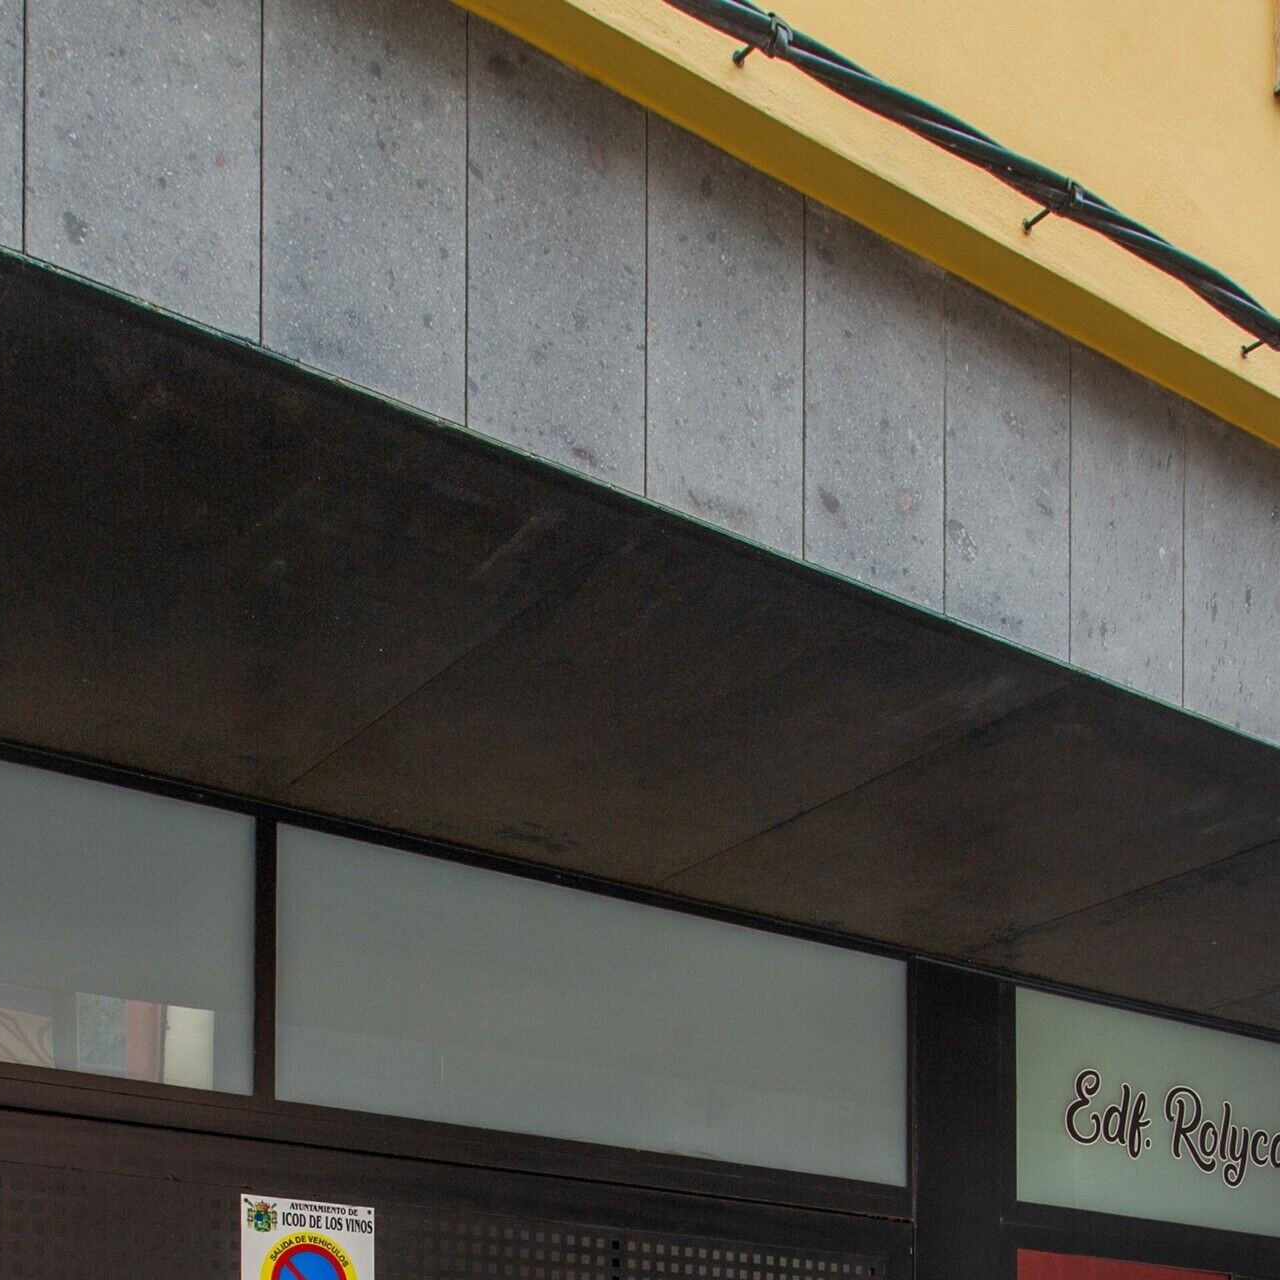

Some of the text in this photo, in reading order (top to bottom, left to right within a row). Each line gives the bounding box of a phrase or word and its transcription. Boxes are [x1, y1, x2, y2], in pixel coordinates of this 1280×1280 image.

[1065, 1068, 1152, 1160] Edf.
[282, 1211, 373, 1234] ICOD DE LOS VINOS
[290, 1202, 358, 1216] AYUNTAMIENTO DE
[269, 1234, 350, 1268] SALIDA DE VEHICULOS
